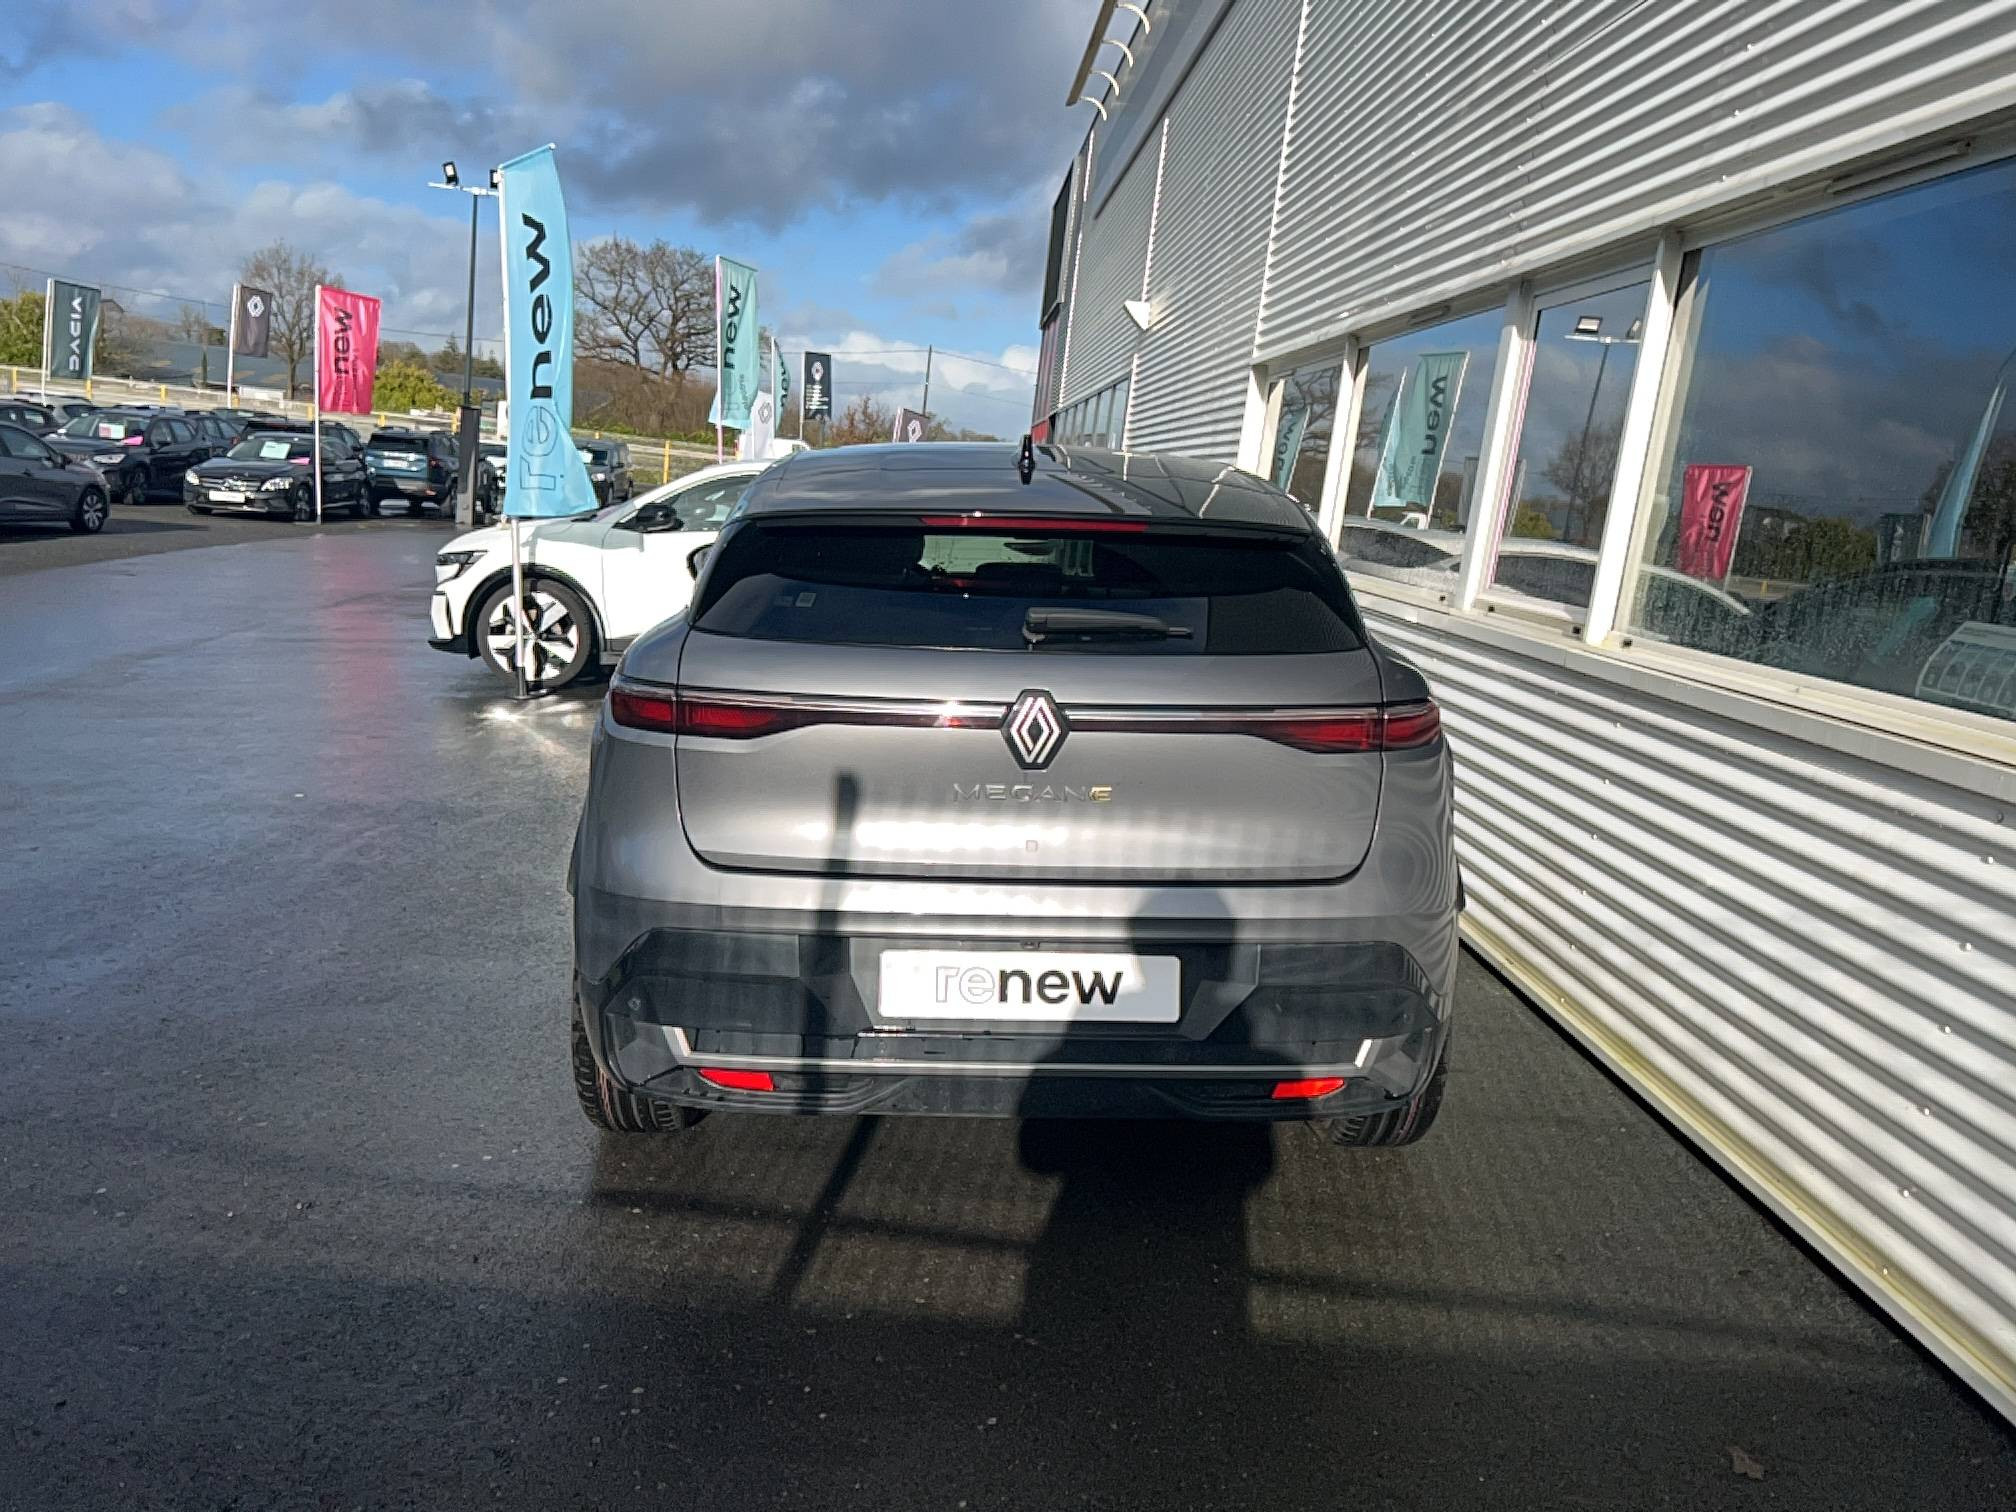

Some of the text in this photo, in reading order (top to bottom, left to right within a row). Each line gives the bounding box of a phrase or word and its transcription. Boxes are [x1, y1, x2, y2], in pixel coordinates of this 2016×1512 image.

[68, 296, 82, 371] DACIA
[519, 212, 559, 491] renew
[952, 783, 1113, 803] MEGANE
[935, 965, 1125, 1005] renew
